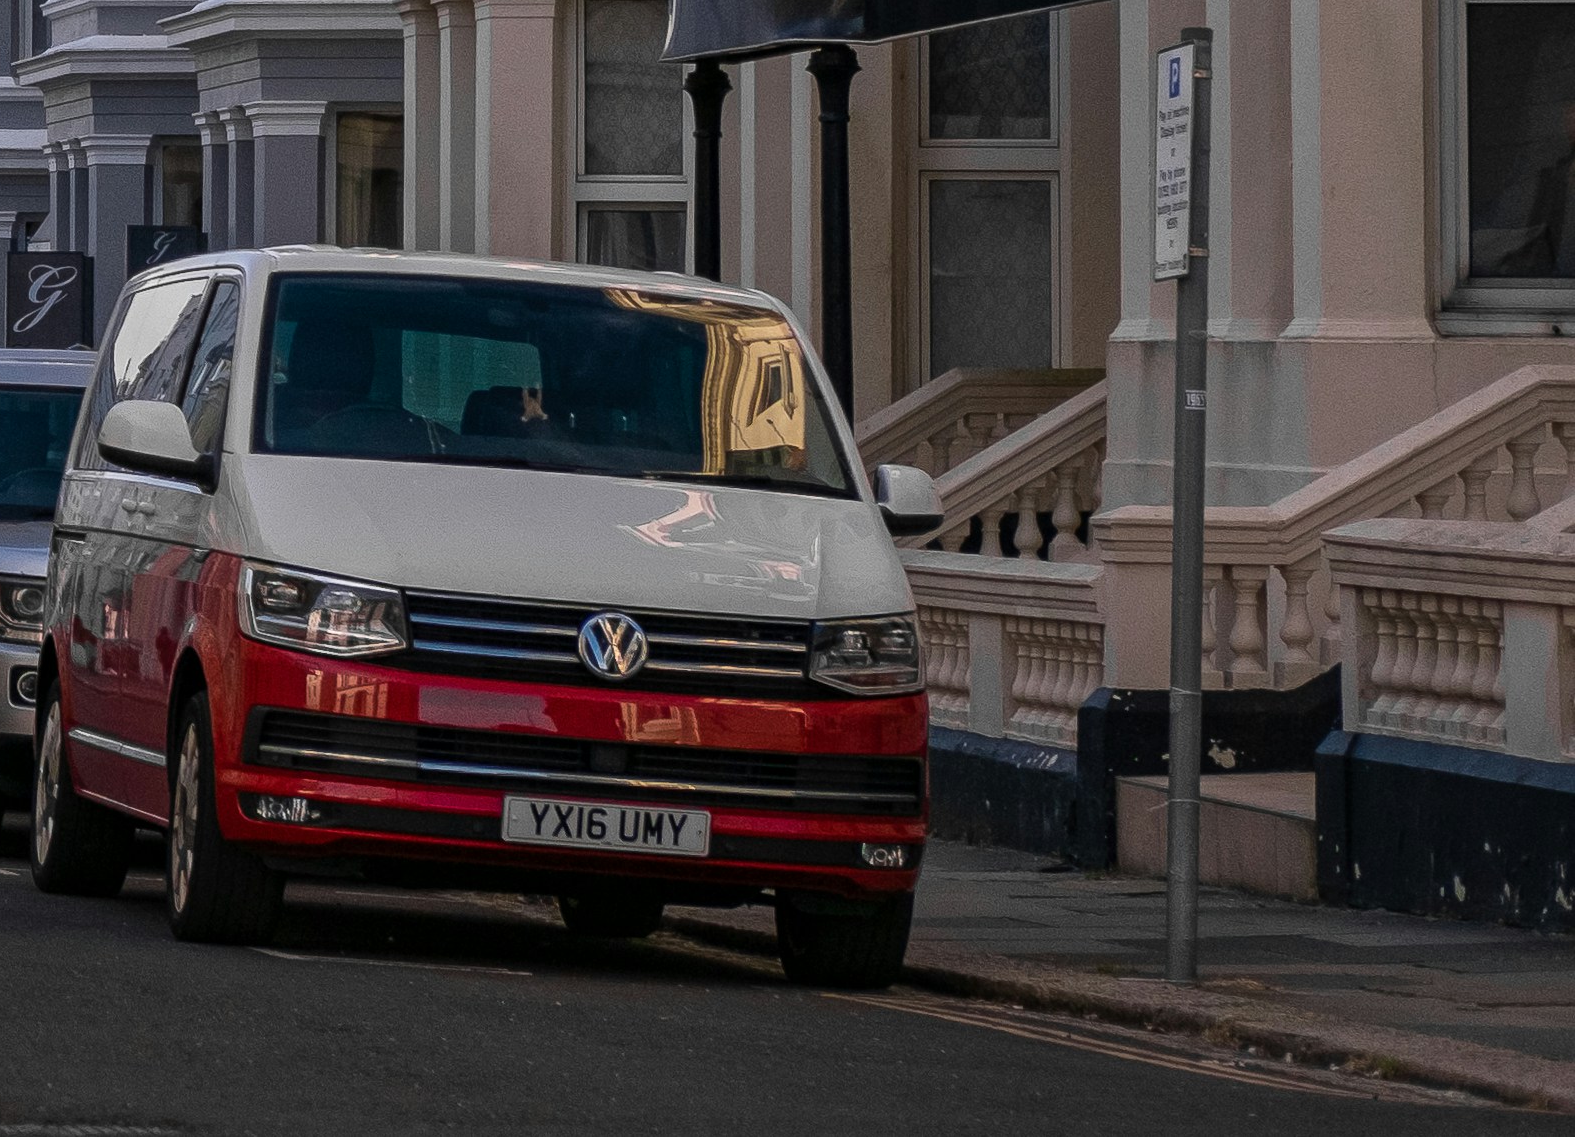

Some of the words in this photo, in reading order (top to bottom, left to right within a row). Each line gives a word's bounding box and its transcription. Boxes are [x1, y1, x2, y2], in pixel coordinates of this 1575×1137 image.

[12, 263, 78, 333] G
[530, 802, 608, 840] YX16
[619, 809, 688, 847] UMY
